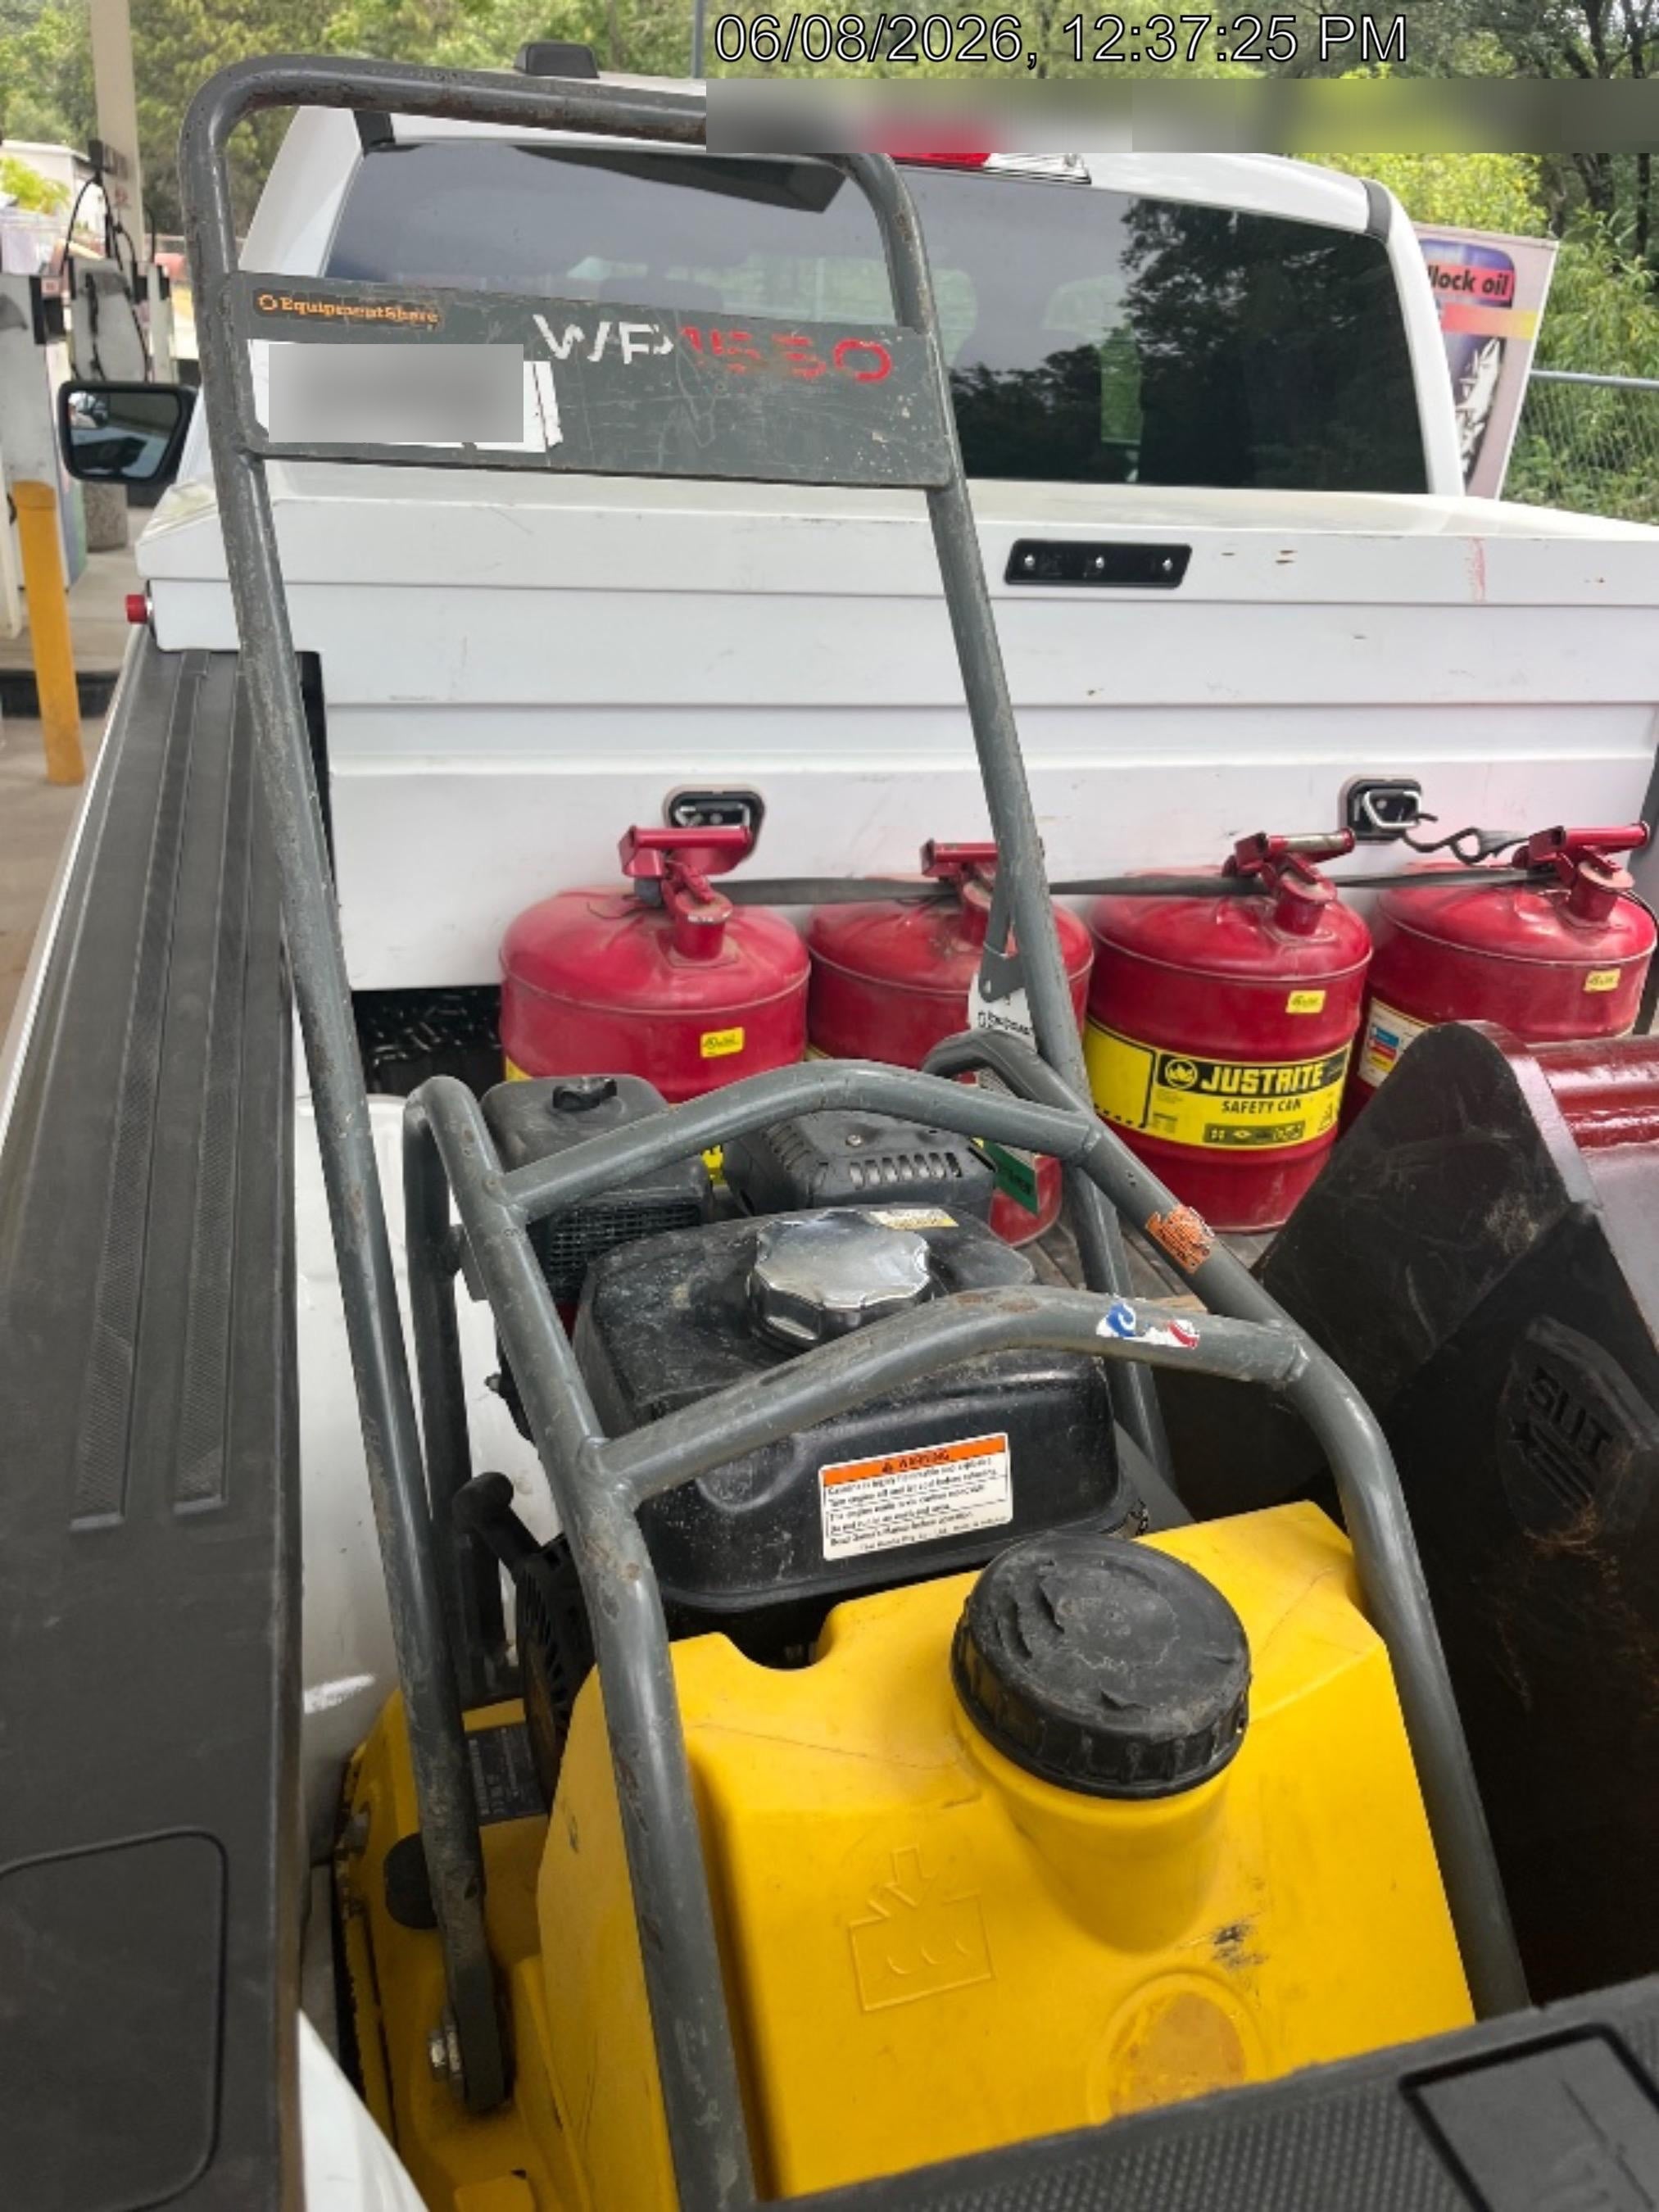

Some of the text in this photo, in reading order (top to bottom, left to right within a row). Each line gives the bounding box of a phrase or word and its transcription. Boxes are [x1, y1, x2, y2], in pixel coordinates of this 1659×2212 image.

[1481, 272, 1509, 296] oil
[279, 296, 440, 324] EquipmentShare
[1201, 1063, 1323, 1094] JUSTRITE
[1221, 1099, 1302, 1115] SAFETY CAN
